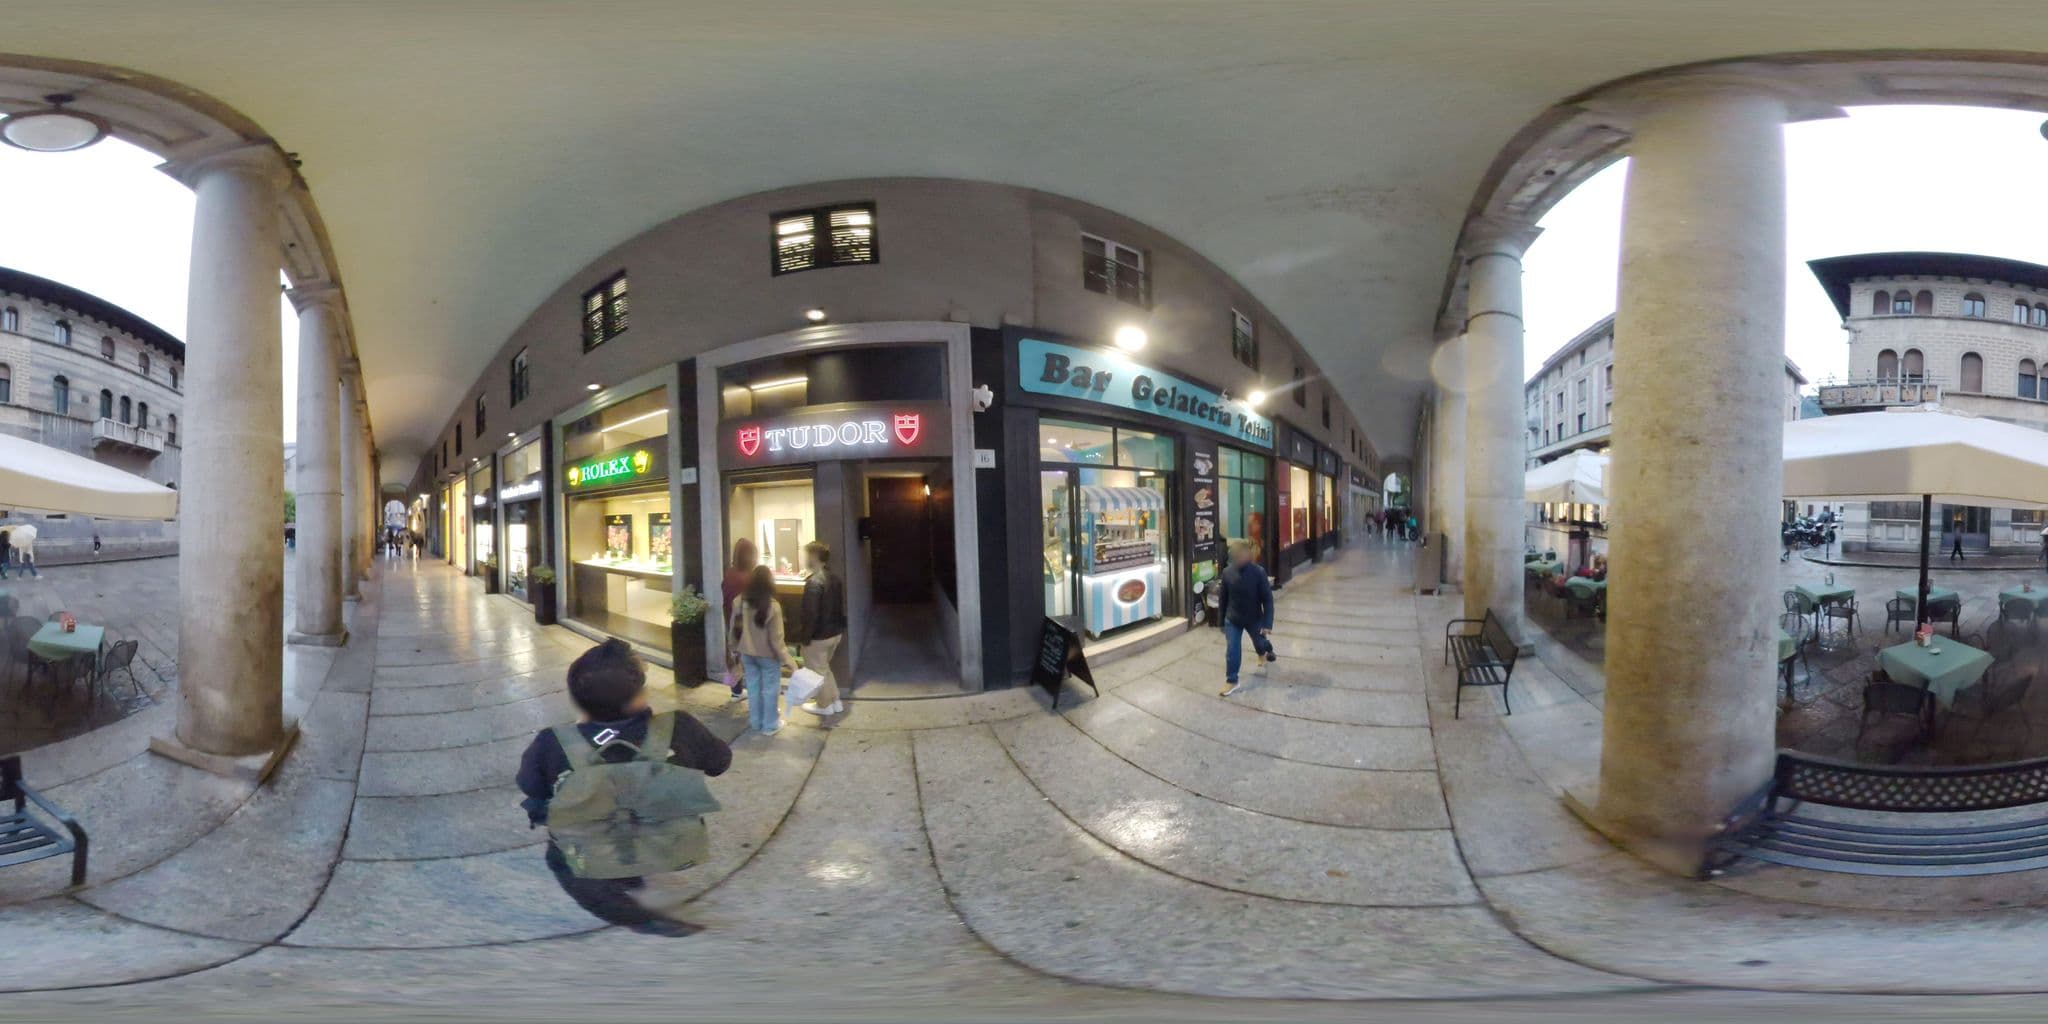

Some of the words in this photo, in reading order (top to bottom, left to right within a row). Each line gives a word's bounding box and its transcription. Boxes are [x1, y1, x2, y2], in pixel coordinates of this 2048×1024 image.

[1040, 352, 1112, 393] Bar
[1131, 375, 1232, 427] Gelateria
[1237, 412, 1272, 442] Tolini
[765, 420, 889, 452] TUDOR
[580, 456, 632, 482] ROLEX
[980, 453, 991, 464] 16
